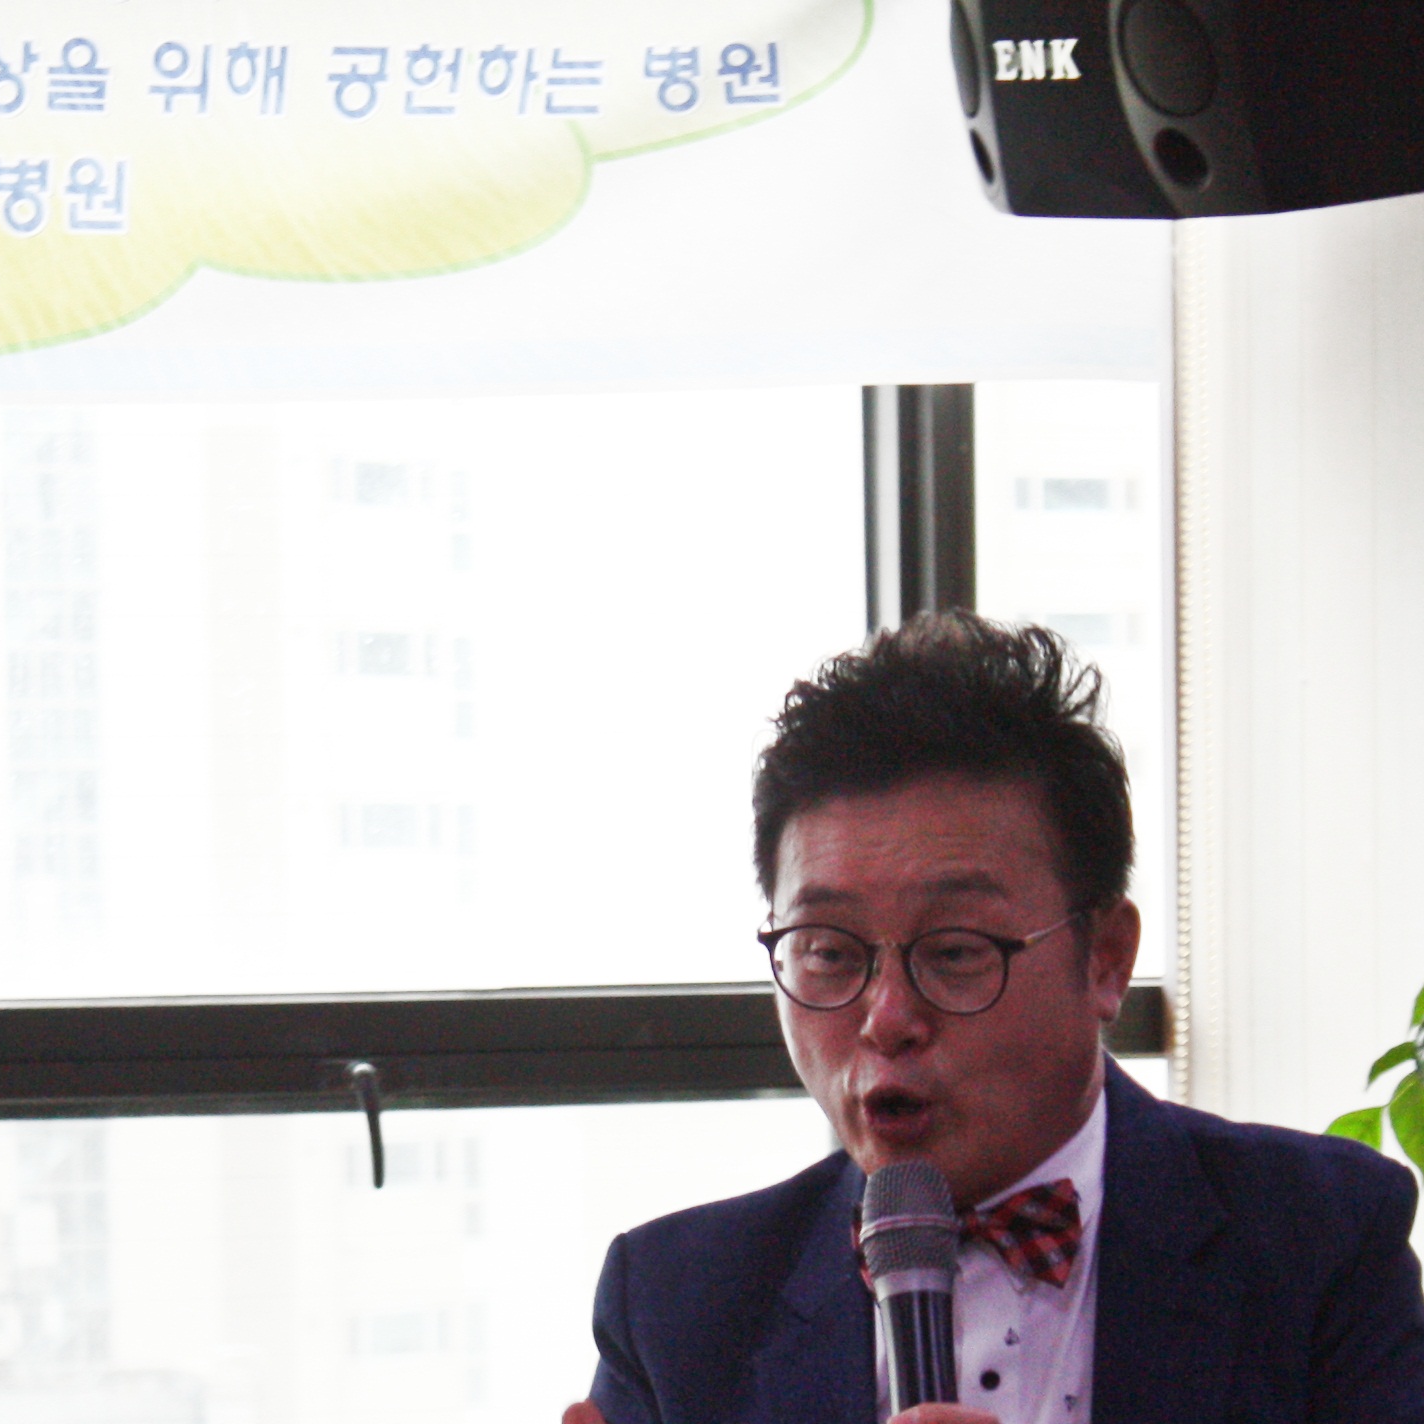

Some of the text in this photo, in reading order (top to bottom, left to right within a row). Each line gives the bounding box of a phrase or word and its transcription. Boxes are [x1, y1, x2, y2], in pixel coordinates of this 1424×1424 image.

[148, 40, 289, 116] 위해
[326, 42, 604, 120] 공헌하는
[643, 40, 782, 113] 병원
